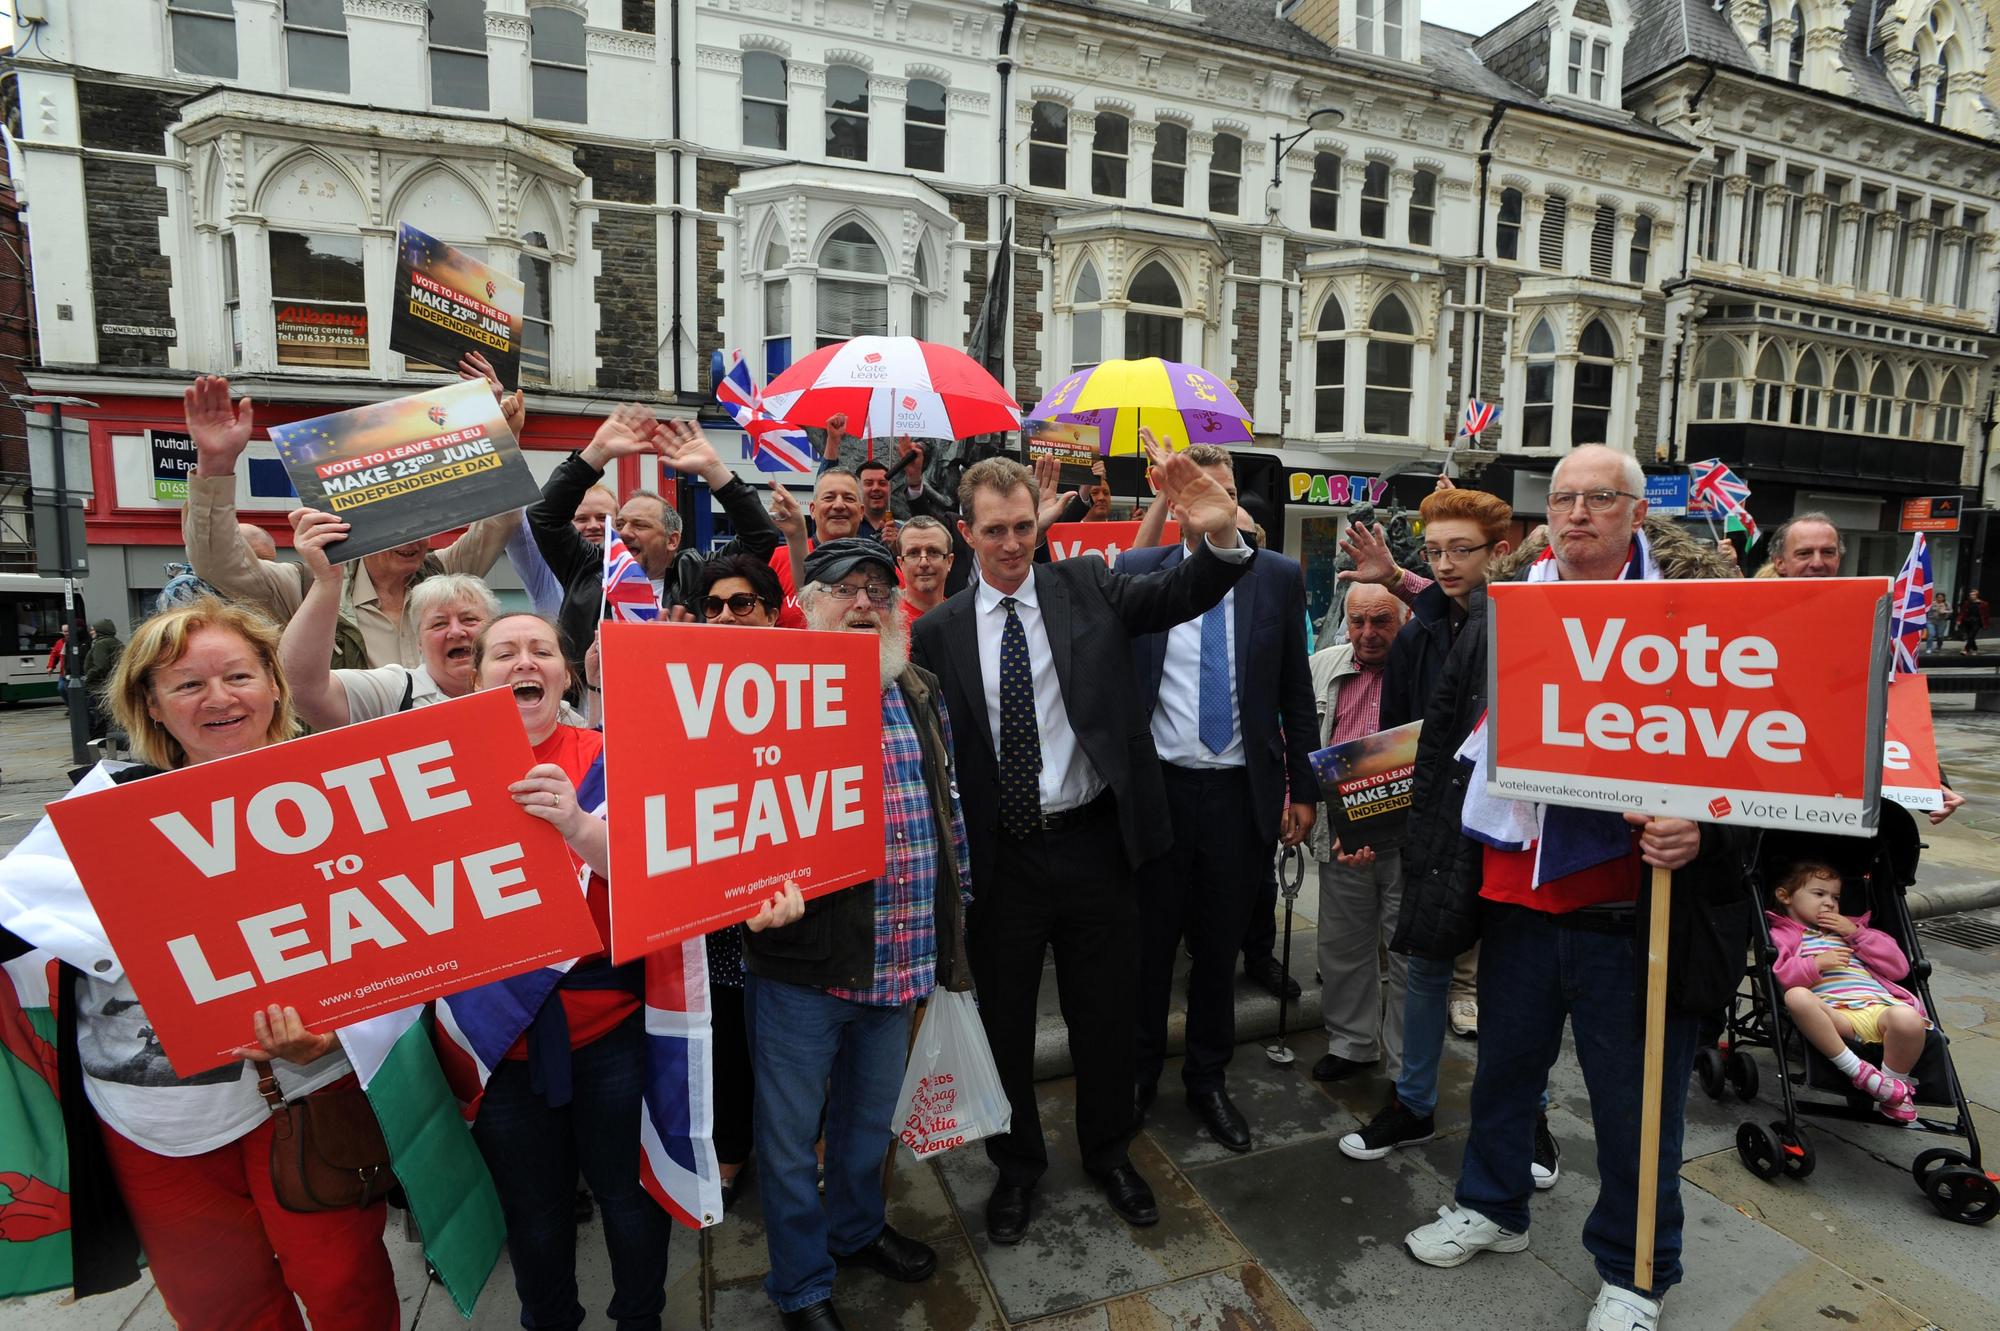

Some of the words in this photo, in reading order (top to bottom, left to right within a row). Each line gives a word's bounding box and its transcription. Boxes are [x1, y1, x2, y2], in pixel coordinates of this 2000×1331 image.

[411, 285, 449, 313] MAKE
[452, 305, 477, 320] 23RD
[479, 316, 510, 339] JUNE
[416, 274, 438, 292] VOTE
[440, 286, 452, 297] TO
[454, 293, 479, 310] LEAVE
[481, 305, 496, 317] THE
[497, 312, 508, 322] EU
[104, 325, 146, 335] COMMERCIAL
[149, 328, 174, 336] STREET
[277, 304, 366, 335] Albany
[278, 322, 318, 334] slimming
[321, 327, 353, 335] centres
[412, 304, 487, 341] INDEPENDENCE
[489, 337, 507, 349] DAY
[298, 334, 326, 342] 01633
[329, 336, 365, 345] 243533
[851, 371, 887, 379] Leave
[857, 364, 887, 372] Vote
[155, 438, 189, 450] nuttall
[322, 461, 361, 475] VOTE
[364, 454, 384, 465] TO
[388, 442, 432, 459] LEAVE
[433, 434, 461, 446] THE
[463, 428, 481, 439] EU
[160, 458, 174, 469] All
[322, 466, 391, 495] MAKE
[392, 454, 435, 477] 23RD
[441, 438, 495, 465] JUNE
[336, 466, 463, 508] INDEPENDENCE
[466, 456, 495, 472] DAY
[1290, 473, 1388, 505] PARTY
[1562, 618, 1778, 689] Vote
[666, 662, 847, 740] VOTE
[1542, 683, 1806, 763] Leave
[753, 745, 781, 767] TO
[1342, 781, 1369, 792] VOTE
[1370, 775, 1384, 784] TO
[1342, 786, 1388, 808] MAKE
[1500, 780, 1643, 806] voteleavetakecontrol.org
[1897, 792, 1933, 805] Leave
[149, 740, 472, 878] VOTE
[644, 765, 865, 878] LEAVE
[1741, 800, 1788, 819] Vote
[1795, 805, 1857, 826] Leave
[314, 853, 364, 881] TO
[724, 866, 812, 899] www.getbritainout.org
[166, 842, 542, 1005] LEAVE
[319, 959, 458, 1007] www.getbritainout.org
